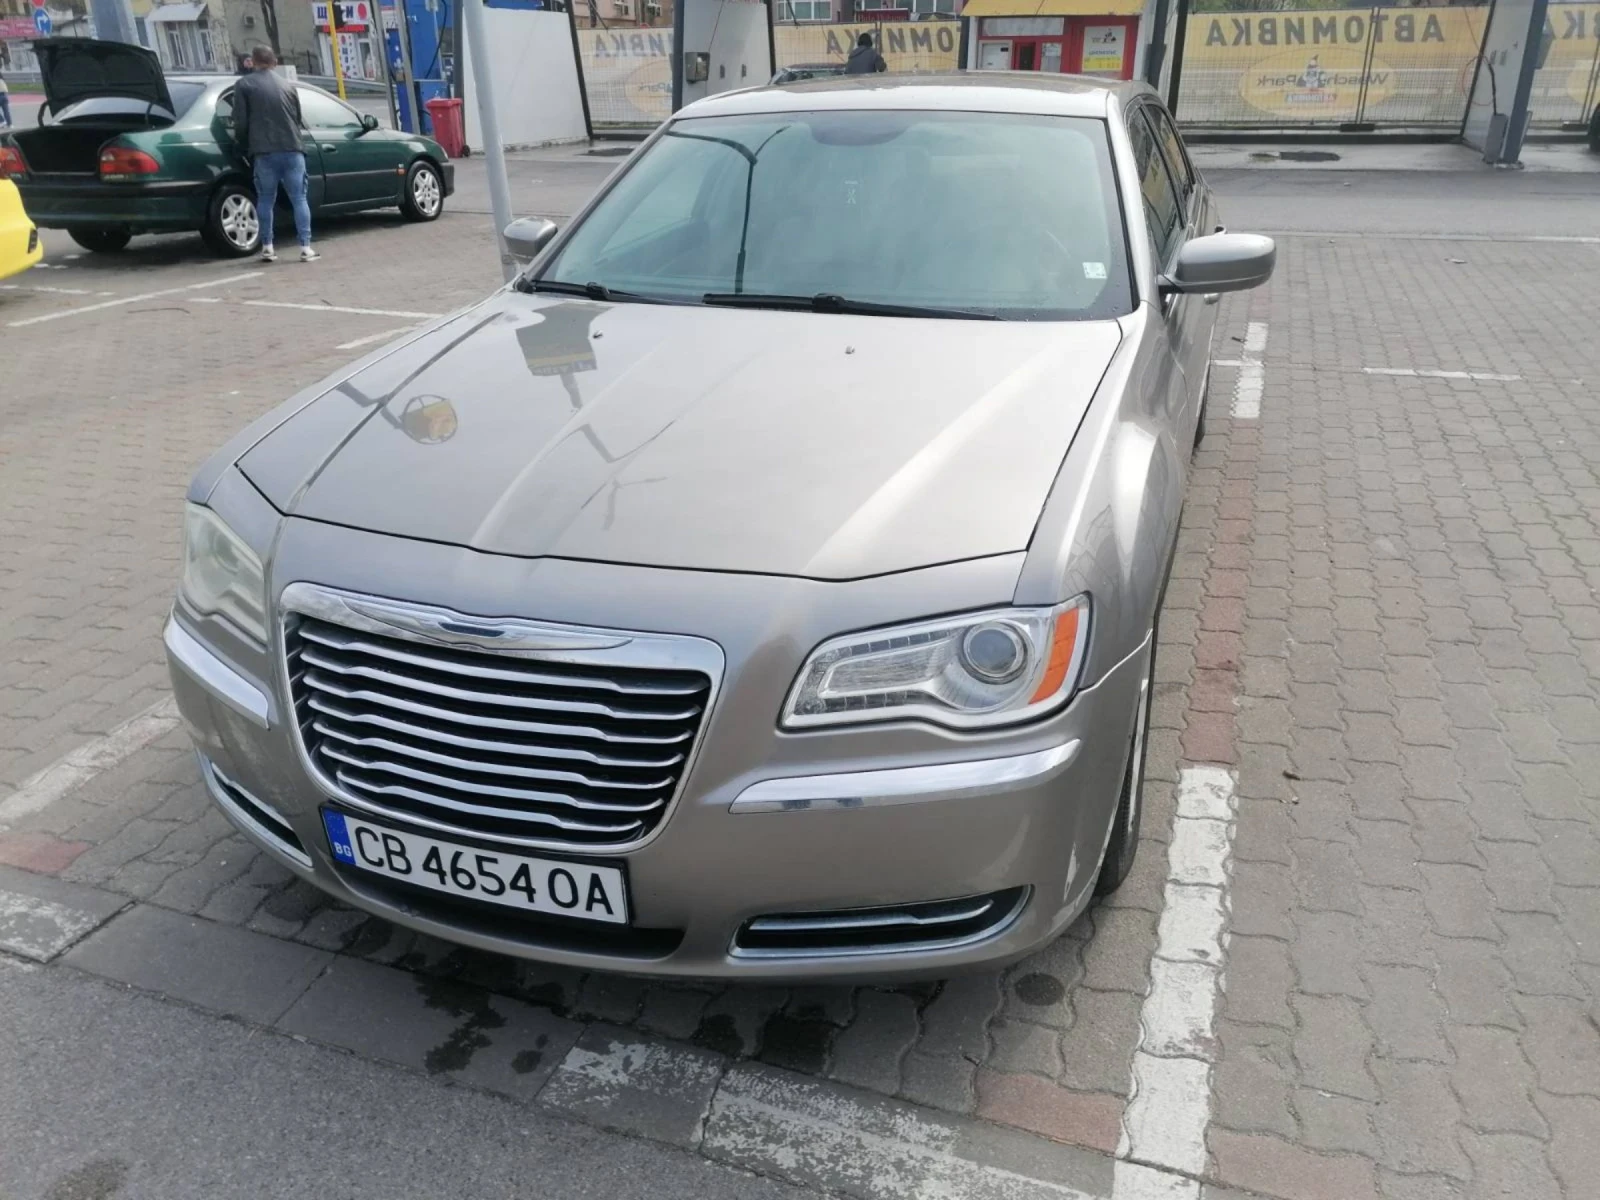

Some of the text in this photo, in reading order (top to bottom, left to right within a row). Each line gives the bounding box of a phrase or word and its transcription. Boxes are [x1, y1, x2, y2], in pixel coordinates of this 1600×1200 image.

[334, 842, 352, 858] BG
[354, 827, 614, 915] CB 4654 OA
